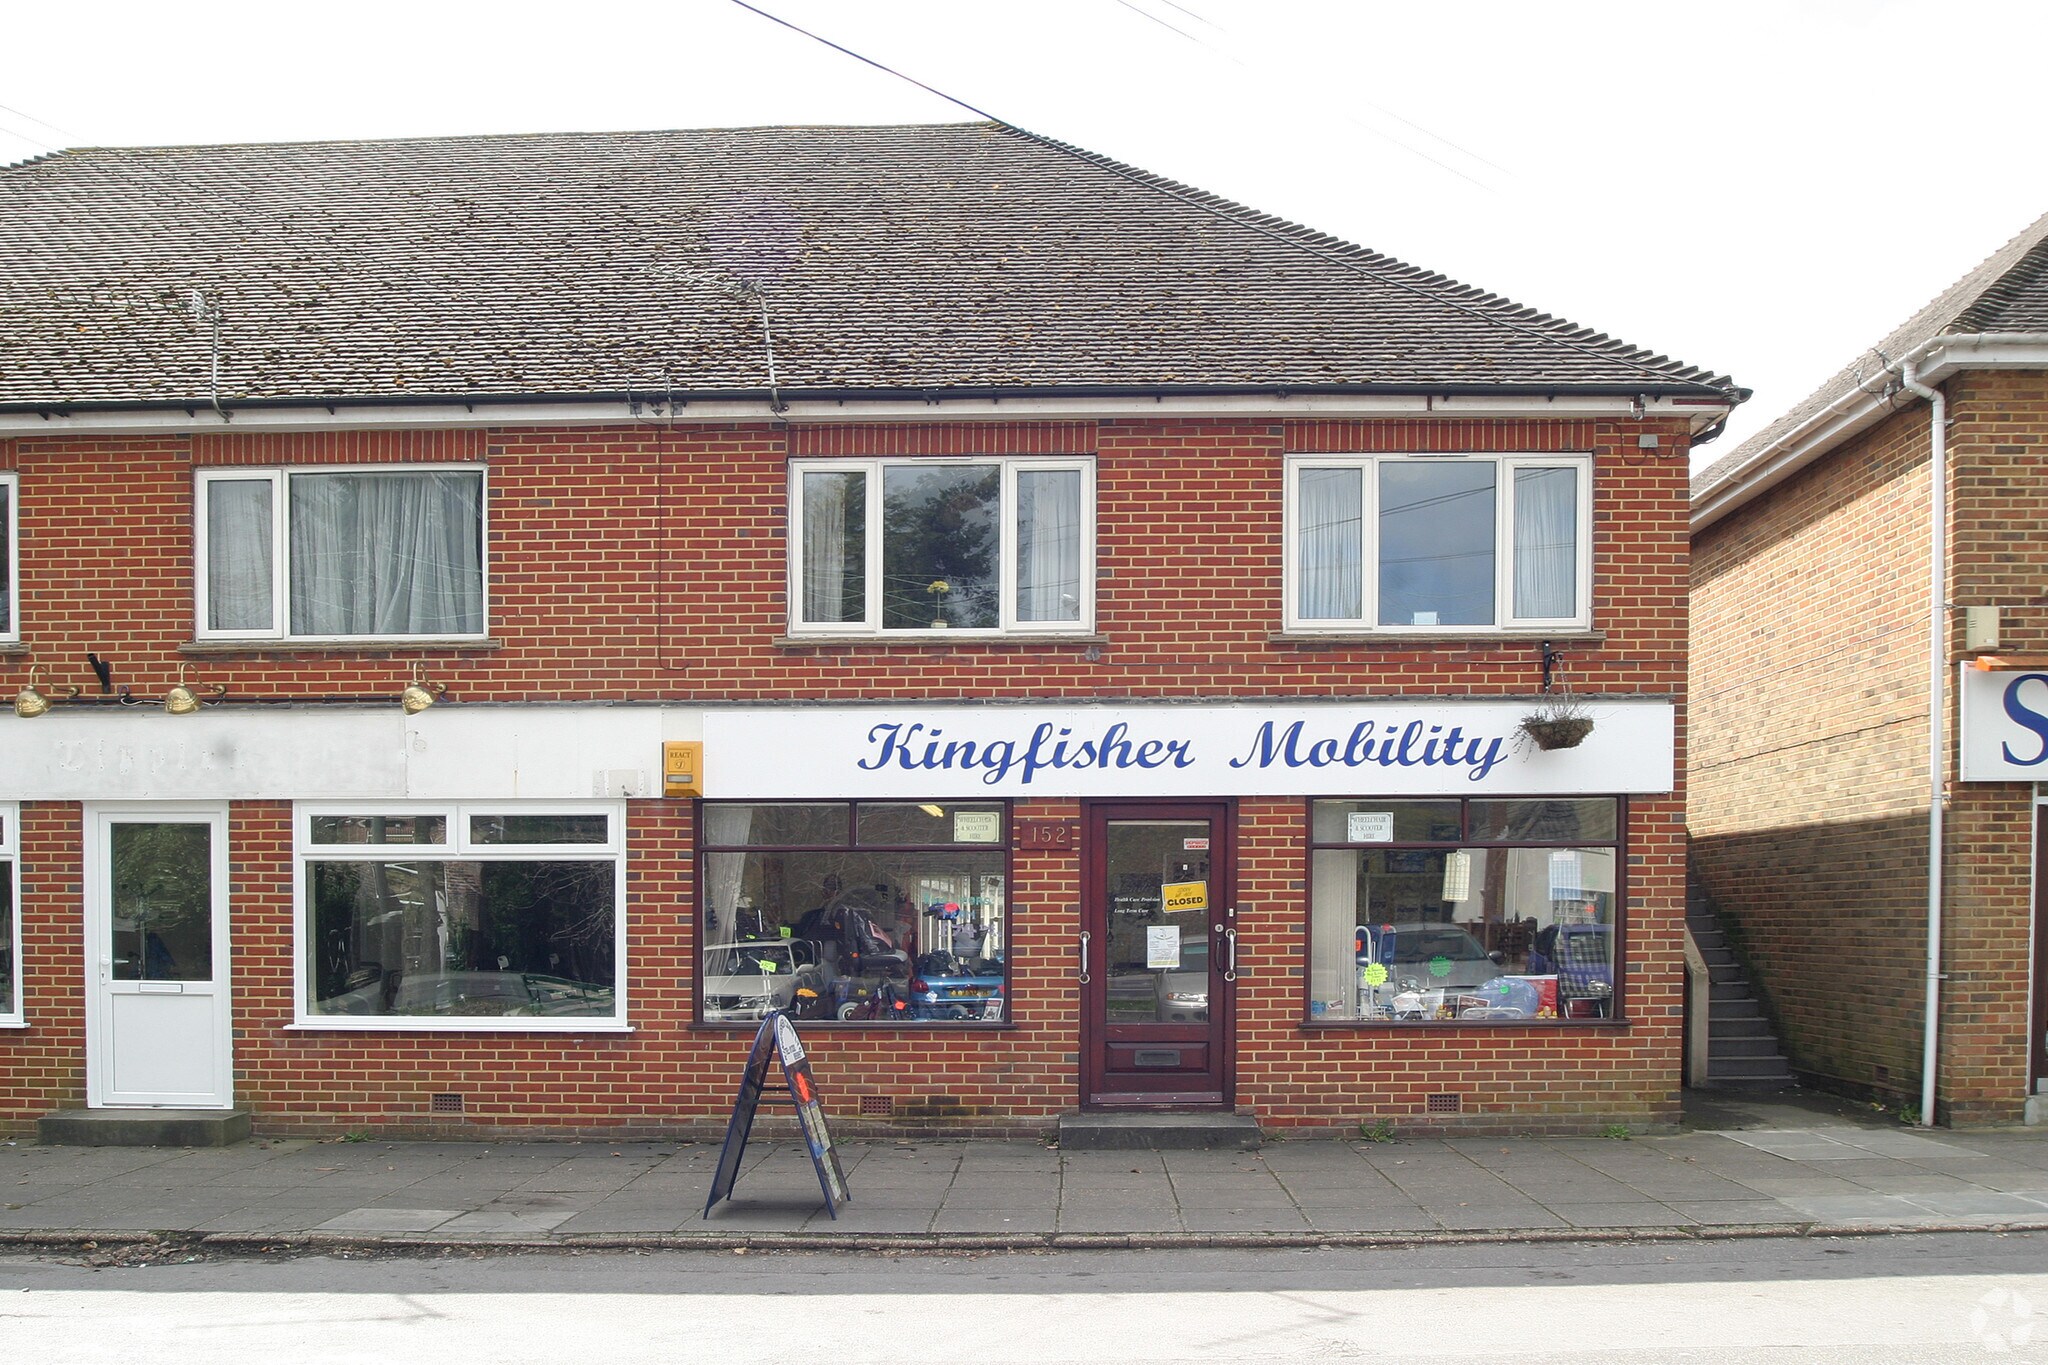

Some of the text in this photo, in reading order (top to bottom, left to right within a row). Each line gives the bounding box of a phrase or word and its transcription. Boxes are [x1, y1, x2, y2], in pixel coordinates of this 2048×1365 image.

[669, 751, 691, 759] REACT
[857, 720, 1509, 785] Kingfisher Mobility
[1032, 826, 1066, 842] 152
[1166, 896, 1204, 907] CLOSED
